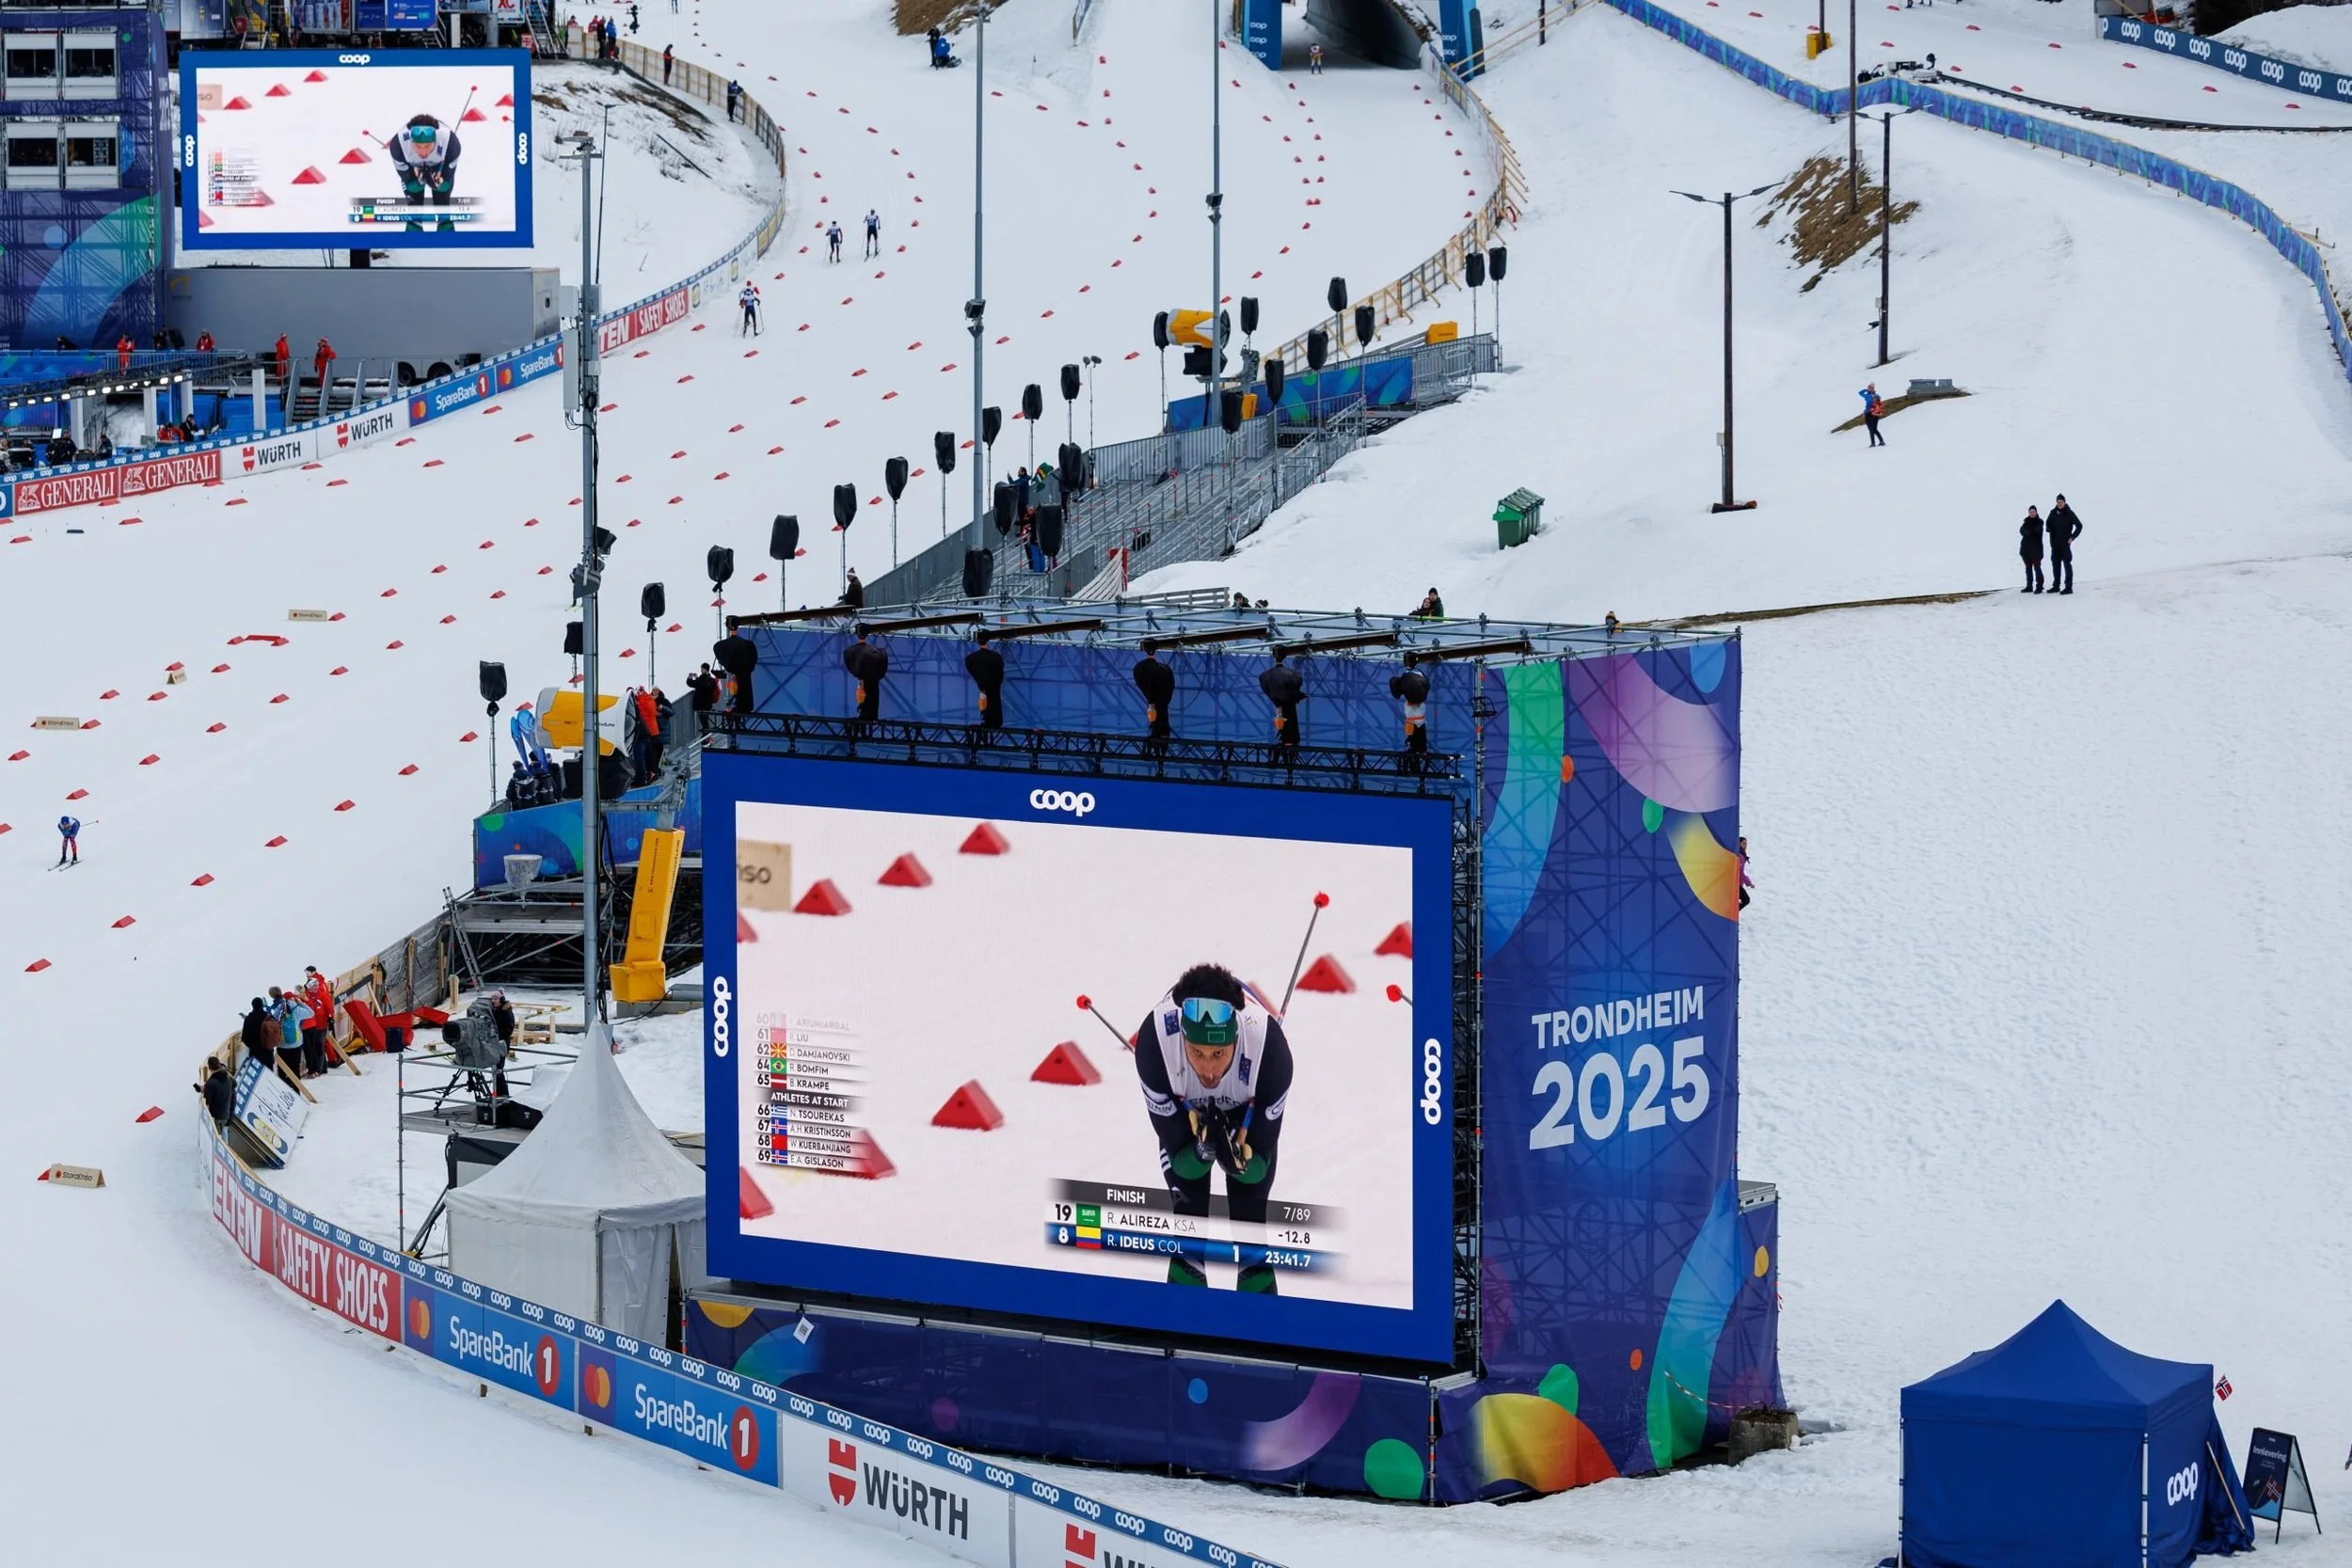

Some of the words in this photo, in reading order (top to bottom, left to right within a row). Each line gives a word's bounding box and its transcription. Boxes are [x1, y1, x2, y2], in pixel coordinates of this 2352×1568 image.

[339, 55, 371, 65] coop
[2122, 23, 2140, 41] coop
[2154, 29, 2175, 50] coop
[2190, 39, 2210, 60] coop
[2225, 50, 2247, 71] coop
[2262, 60, 2283, 83] coop
[2299, 71, 2321, 92] coop
[2337, 78, 2352, 95] coo
[185, 135, 196, 167] coop
[517, 133, 528, 165] coop
[639, 302, 662, 335] SAFETY
[665, 290, 686, 322] SHOES
[597, 316, 629, 353] TEN
[520, 353, 555, 380] SpareBank
[436, 381, 477, 410] SpareBank
[145, 453, 217, 490] GENERALI
[40, 471, 115, 508] GENERALI
[1030, 789, 1095, 817] coop
[713, 975, 732, 1058] coop
[1531, 985, 1705, 1050] TRONDHEIM
[757, 1028, 770, 1039] 61
[756, 1043, 770, 1055] 62
[797, 1049, 850, 1061] DAMJANOVSKI
[756, 1058, 770, 1070] 64
[797, 1064, 829, 1074] BOMFIM
[757, 1073, 770, 1085] 65
[797, 1079, 830, 1090] KRAMPE
[1420, 1037, 1441, 1125] coop
[1529, 1036, 1710, 1150] 2025
[757, 1103, 771, 1116] 66
[799, 1110, 845, 1122] TSOUREKAS
[771, 1091, 809, 1104] ATHLETES
[812, 1096, 822, 1105] AT
[823, 1098, 849, 1108] START
[757, 1119, 771, 1132] 67
[804, 1127, 850, 1139] KRISTINSSON
[757, 1134, 771, 1147] 68
[799, 1141, 851, 1154] KUERBANJIANG
[757, 1150, 771, 1162] 69
[804, 1156, 844, 1168] GISLASON
[62, 1171, 93, 1181] StoraEnso
[1106, 1188, 1146, 1204] FINISH
[213, 1158, 262, 1264] ELTEN
[1056, 1203, 1073, 1222] 19
[1107, 1212, 1118, 1225] R.
[1120, 1214, 1170, 1229] ALIREZA
[1174, 1219, 1197, 1232] KSA
[1283, 1206, 1311, 1222] 7/89
[1058, 1227, 1070, 1243] 8
[1107, 1234, 1118, 1247] R.
[1120, 1236, 1155, 1251] IDEUS
[1158, 1239, 1184, 1254] COL
[1232, 1245, 1240, 1262] 1
[1265, 1251, 1311, 1267] 23:41.7
[1278, 1230, 1311, 1244] -12.8
[280, 1223, 330, 1304] SAFETY
[335, 1252, 389, 1333] SHOES
[450, 1315, 533, 1377] SpareBank
[542, 1346, 552, 1385] 1
[260, 1187, 273, 1204] coop
[278, 1197, 287, 1213] coop
[294, 1209, 306, 1225] coop
[313, 1219, 328, 1235] coop
[337, 1229, 350, 1246] coop
[359, 1240, 374, 1257] coop
[384, 1250, 400, 1267] coop
[409, 1260, 425, 1277] coop
[436, 1271, 453, 1289] coop
[463, 1281, 480, 1299] coop
[491, 1291, 510, 1309] coop
[523, 1303, 543, 1321] coop
[555, 1314, 574, 1332] coop
[585, 1324, 604, 1343] coop
[617, 1336, 638, 1354] coop
[650, 1347, 671, 1366] coop
[683, 1358, 704, 1378] coop
[717, 1371, 739, 1390] coop
[753, 1384, 775, 1403] coop
[790, 1398, 813, 1418] coop
[828, 1411, 851, 1430] coop
[865, 1424, 890, 1444] coop
[908, 1438, 932, 1459] coop
[948, 1452, 971, 1473] coop
[986, 1467, 1013, 1488] coop
[1033, 1482, 1058, 1503] coop
[1074, 1497, 1100, 1519] coop
[1116, 1513, 1144, 1535] coop
[1165, 1530, 1192, 1552] coop
[1210, 1545, 1236, 1568] coop
[634, 1383, 728, 1450] SpareBank
[739, 1418, 750, 1458] 1
[2252, 1445, 2287, 1464] Innlevering
[2167, 1461, 2199, 1507] coop
